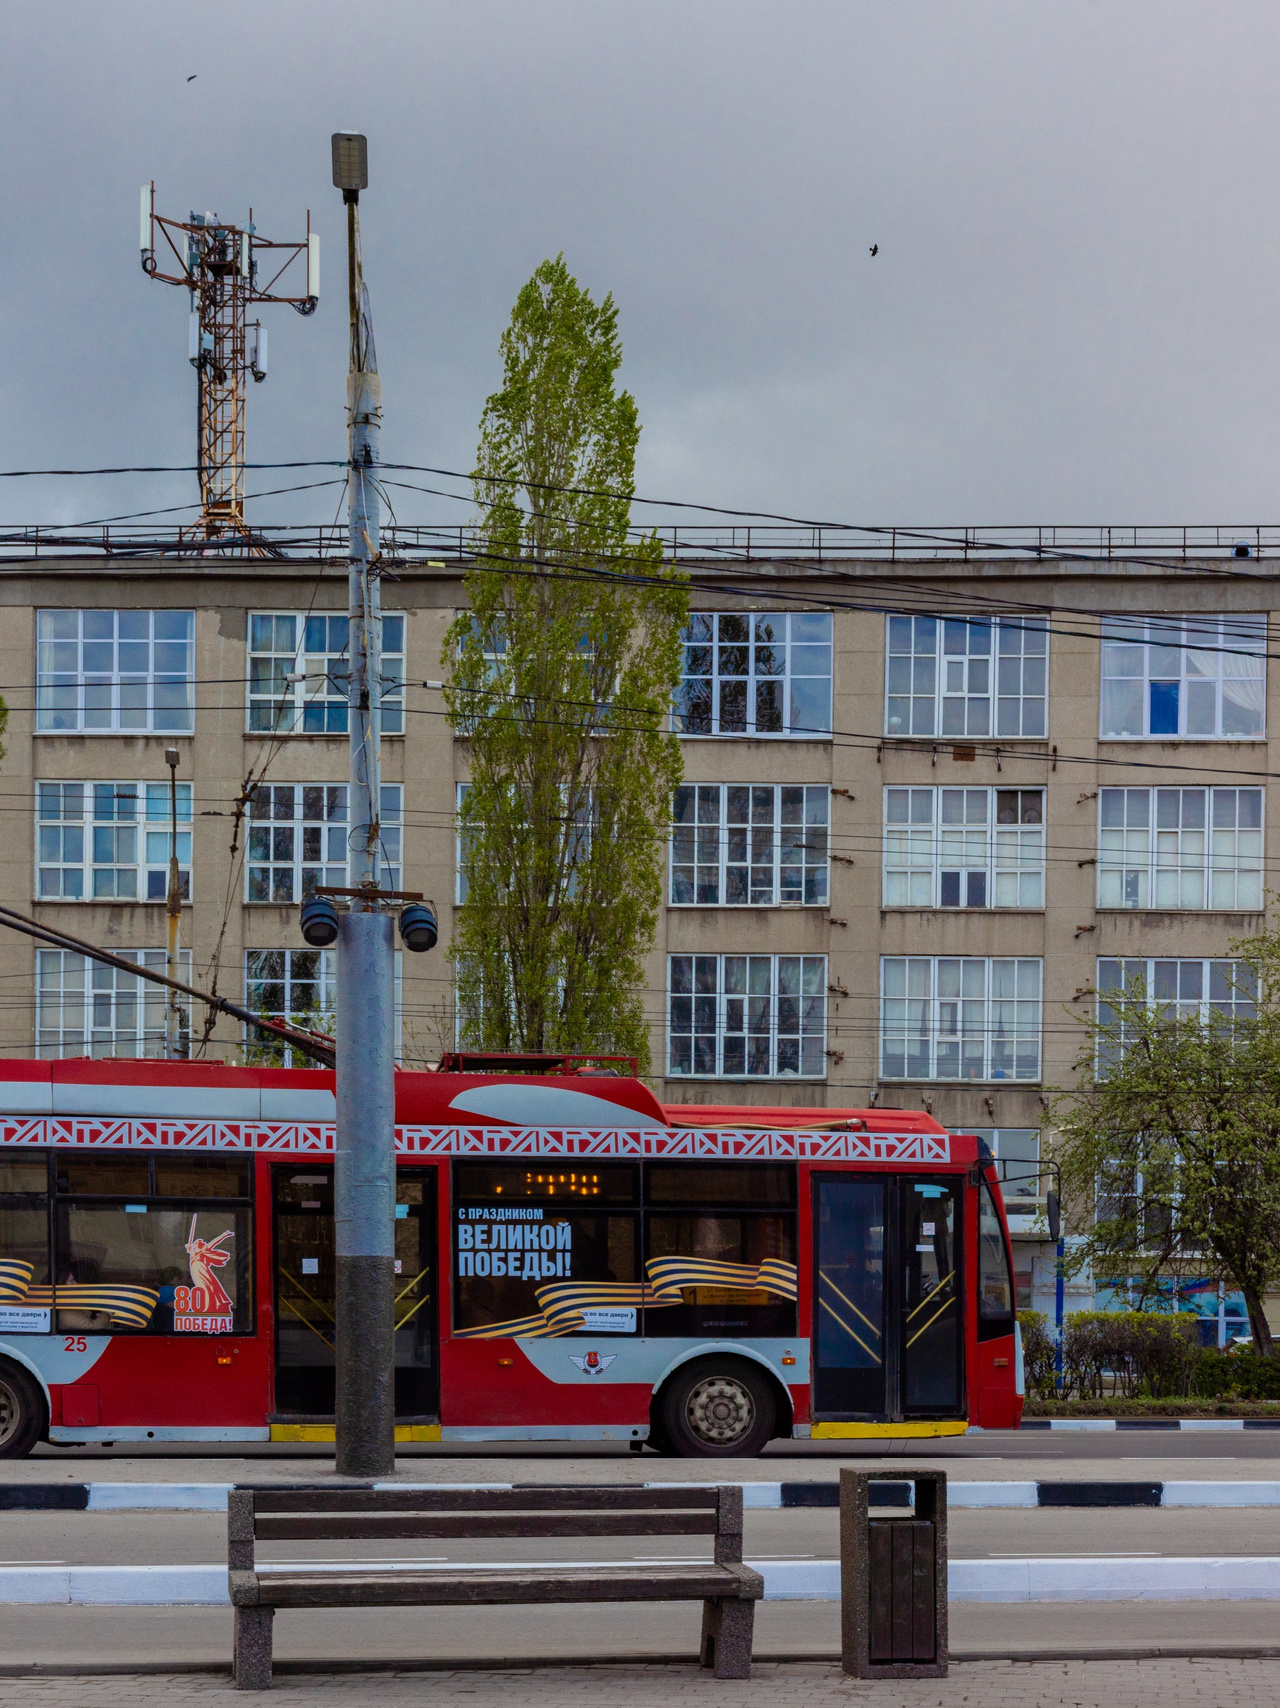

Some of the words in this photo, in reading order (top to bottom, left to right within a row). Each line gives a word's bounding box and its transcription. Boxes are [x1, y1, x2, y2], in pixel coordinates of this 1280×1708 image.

[458, 1208, 466, 1219] С
[468, 1208, 543, 1221] ПРАЗДНИКОМ
[458, 1222, 572, 1250] ВЕЛИКОЙ
[458, 1251, 572, 1281] ПОБЕДЫ!
[175, 1286, 206, 1312] 80
[174, 1318, 233, 1333] ПОБЕДА!
[64, 1336, 87, 1352] 25
